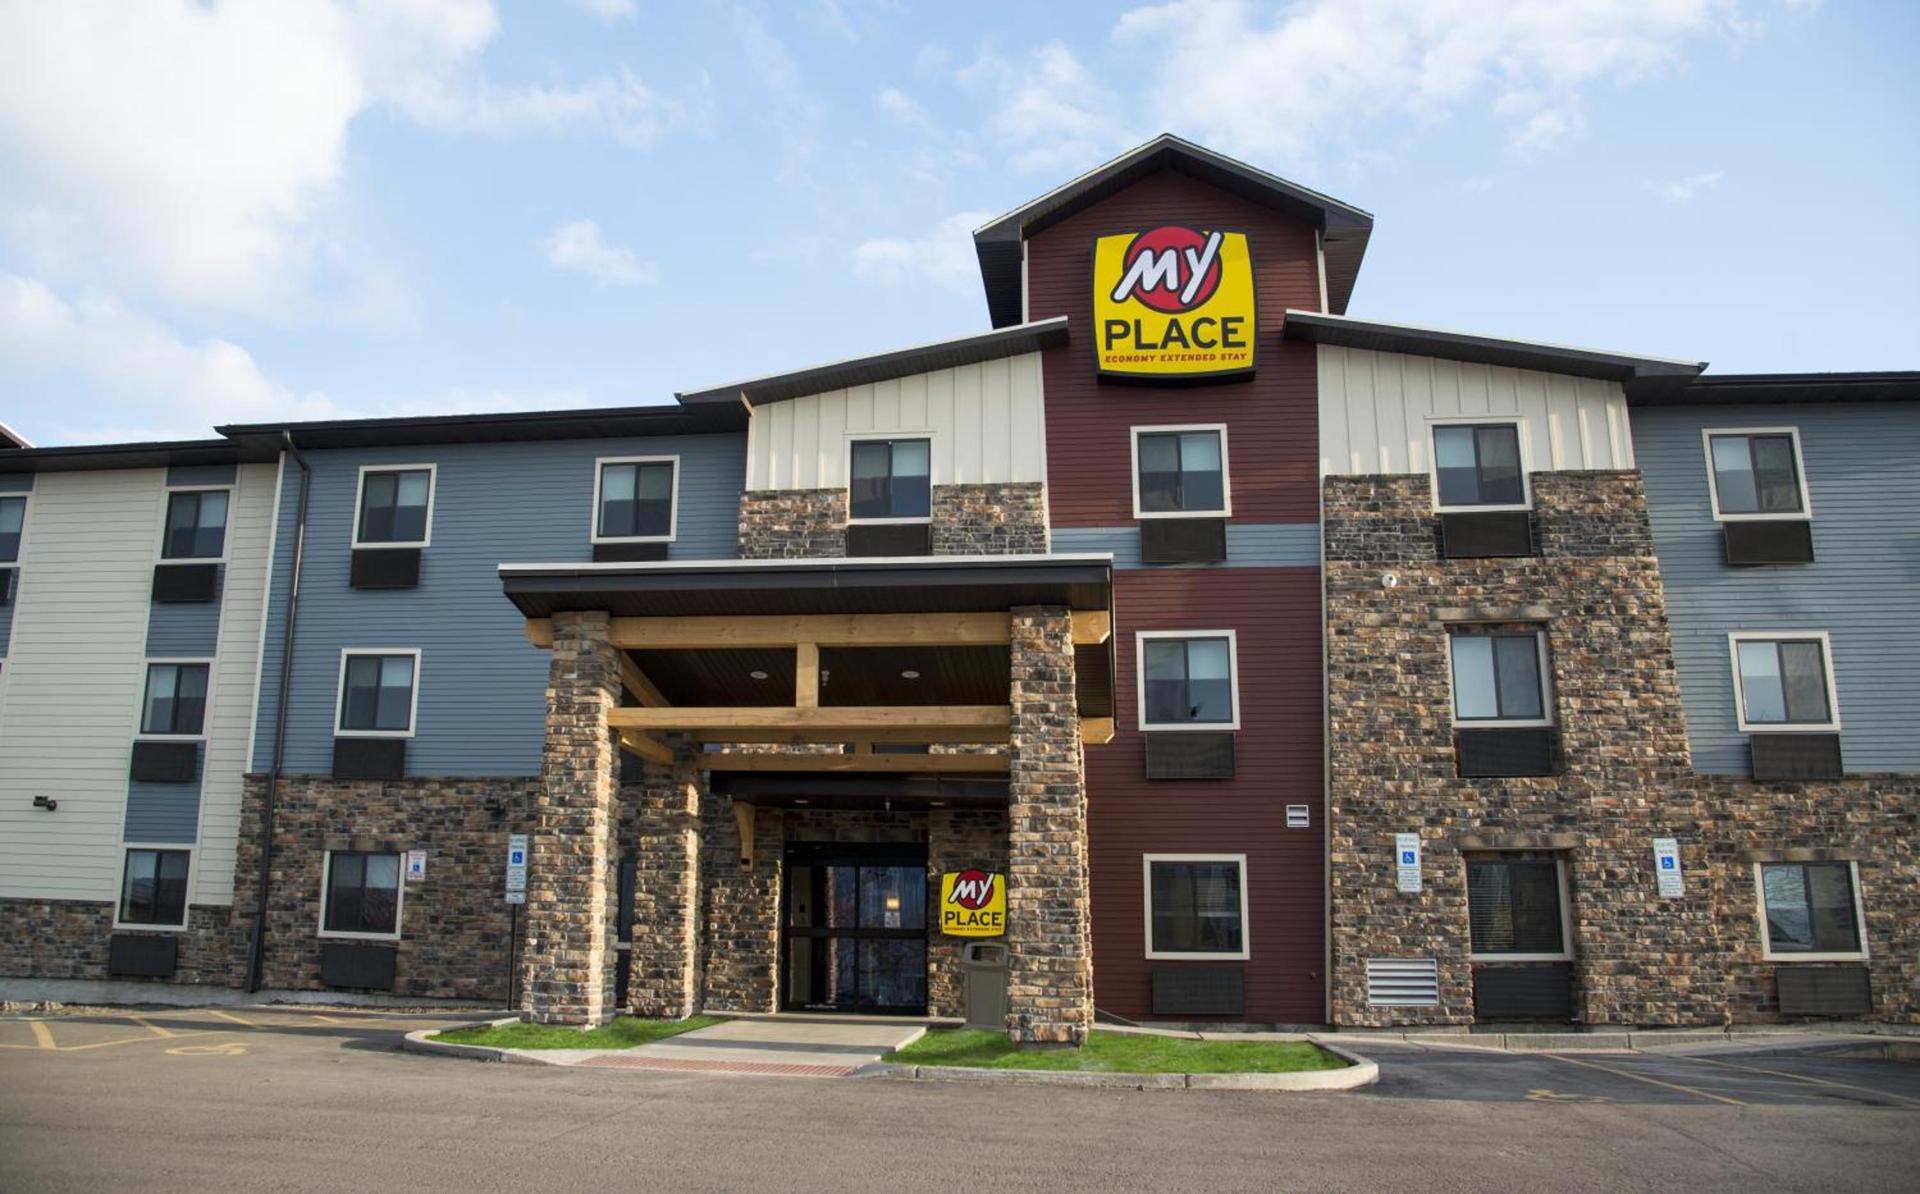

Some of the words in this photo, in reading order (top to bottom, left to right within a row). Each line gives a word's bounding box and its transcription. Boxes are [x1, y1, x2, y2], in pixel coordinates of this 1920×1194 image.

[1105, 317, 1247, 350] PLACE
[1104, 355, 1155, 363] ECONOMY
[1160, 353, 1216, 362] EXTENDED
[1220, 352, 1248, 360] STAY
[944, 911, 1002, 926] PLACE
